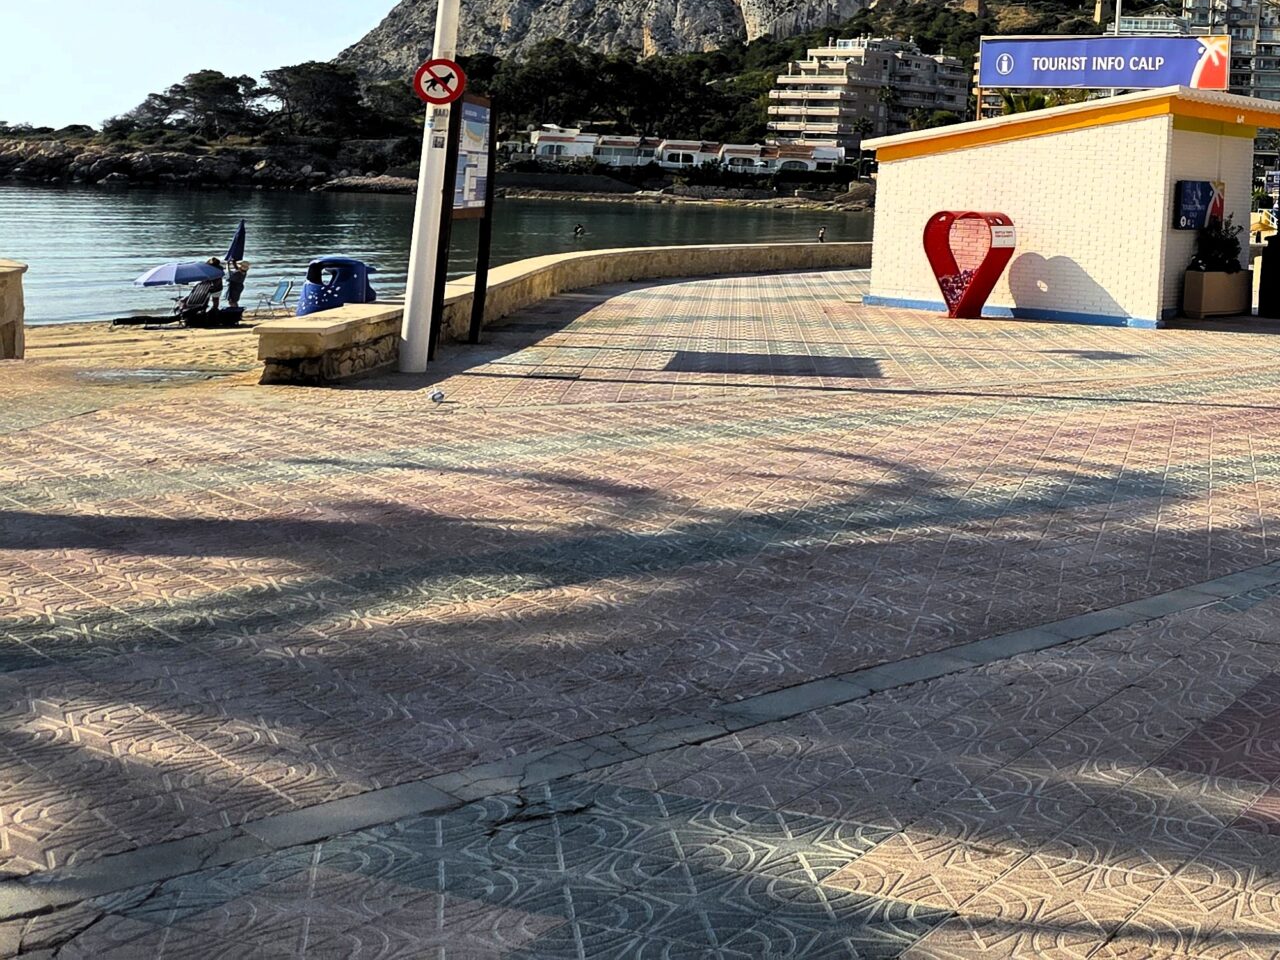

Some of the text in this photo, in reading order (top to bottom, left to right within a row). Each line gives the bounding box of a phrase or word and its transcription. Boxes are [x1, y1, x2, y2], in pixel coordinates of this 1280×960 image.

[1032, 56, 1165, 71] TOURIST INFO CALP
